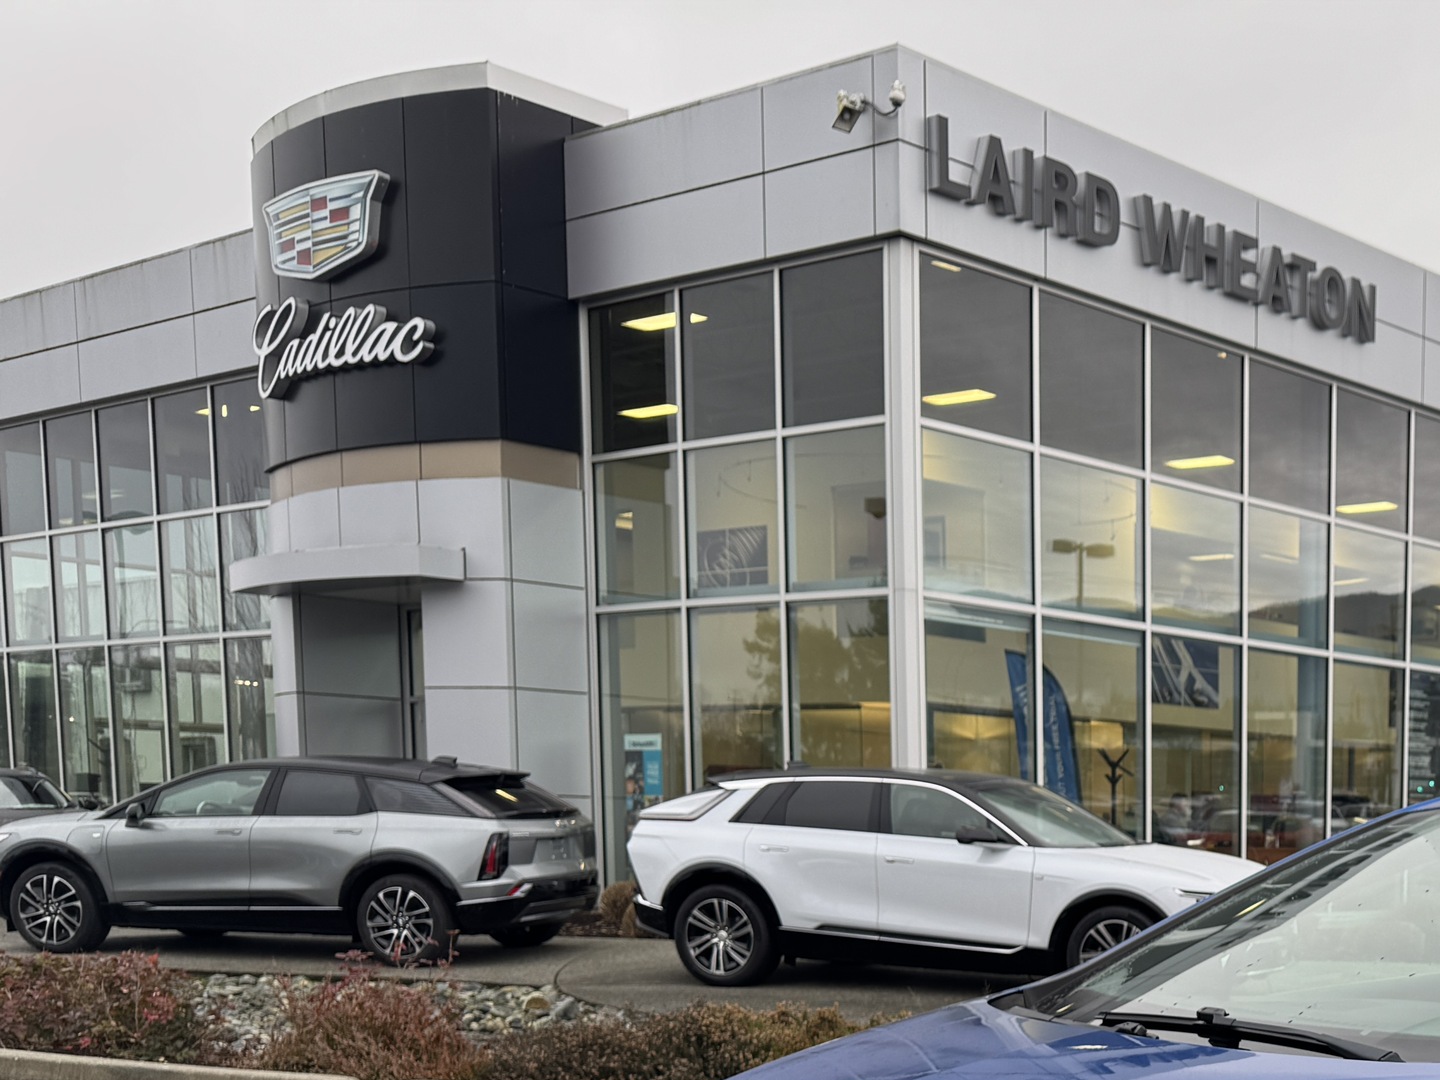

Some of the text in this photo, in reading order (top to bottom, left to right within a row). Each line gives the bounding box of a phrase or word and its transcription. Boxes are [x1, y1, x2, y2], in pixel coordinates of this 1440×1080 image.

[928, 114, 1377, 344] LAIRD WHEATON
[252, 296, 437, 399] Cadillac
